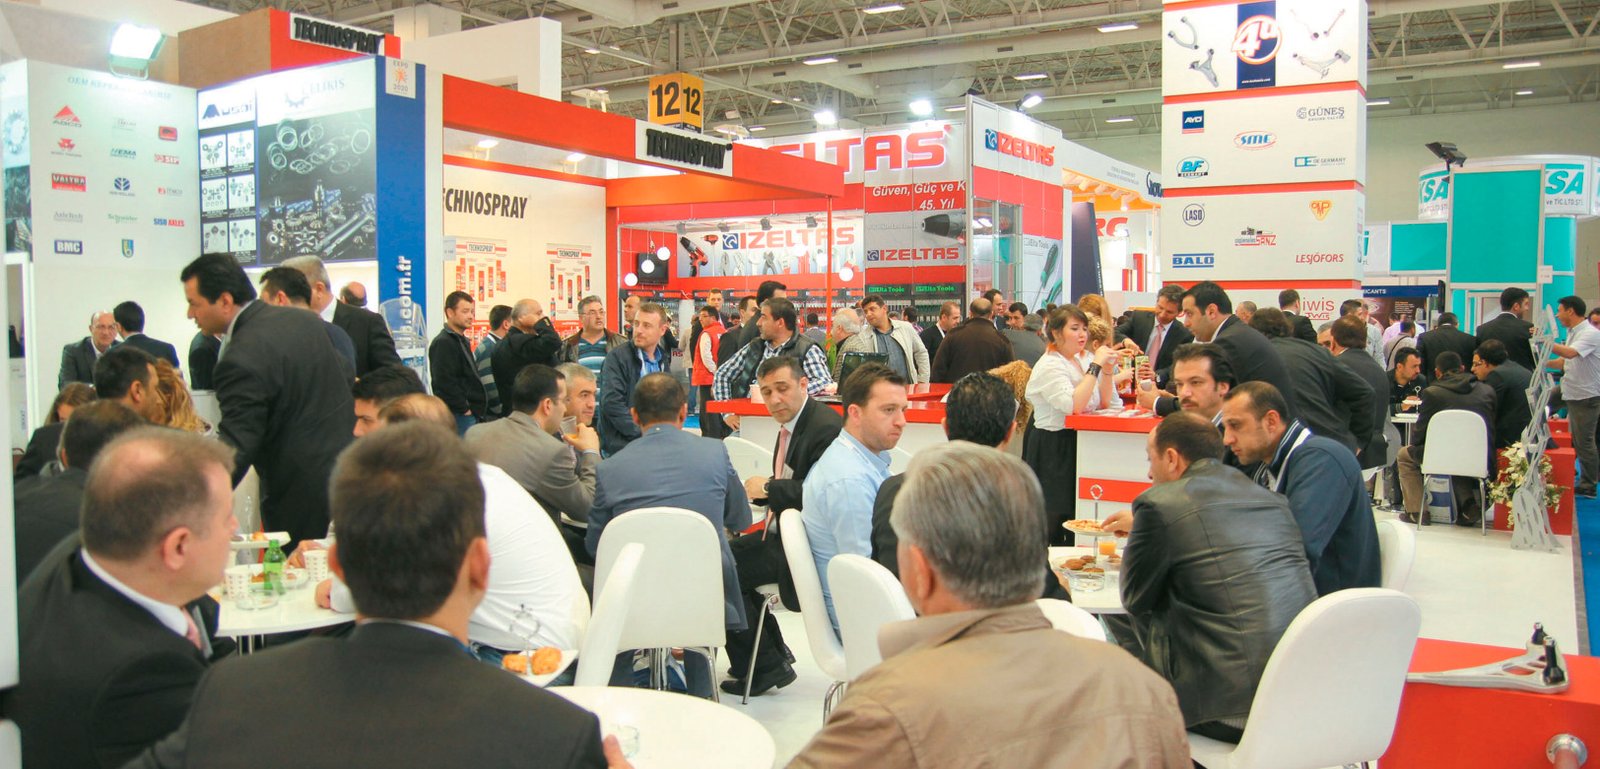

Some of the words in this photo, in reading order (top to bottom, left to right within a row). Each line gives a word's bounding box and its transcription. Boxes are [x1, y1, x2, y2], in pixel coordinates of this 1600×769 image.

[293, 17, 385, 54] TECHNOSPRAY
[652, 82, 680, 117] 12
[682, 86, 701, 116] 12
[1307, 106, 1345, 118] GÜNEŞ
[646, 128, 727, 170] TECHNOSPRAY
[872, 185, 910, 197] Güven,
[914, 182, 937, 196] Güç
[941, 183, 954, 192] ve
[1544, 170, 1584, 195] SA
[443, 188, 528, 219] CHNOSPRAY
[919, 198, 936, 211] 45.
[1185, 209, 1203, 221] LASO
[57, 242, 80, 253] BMC
[879, 247, 959, 261] IZELTAS
[1172, 256, 1215, 265] BALO
